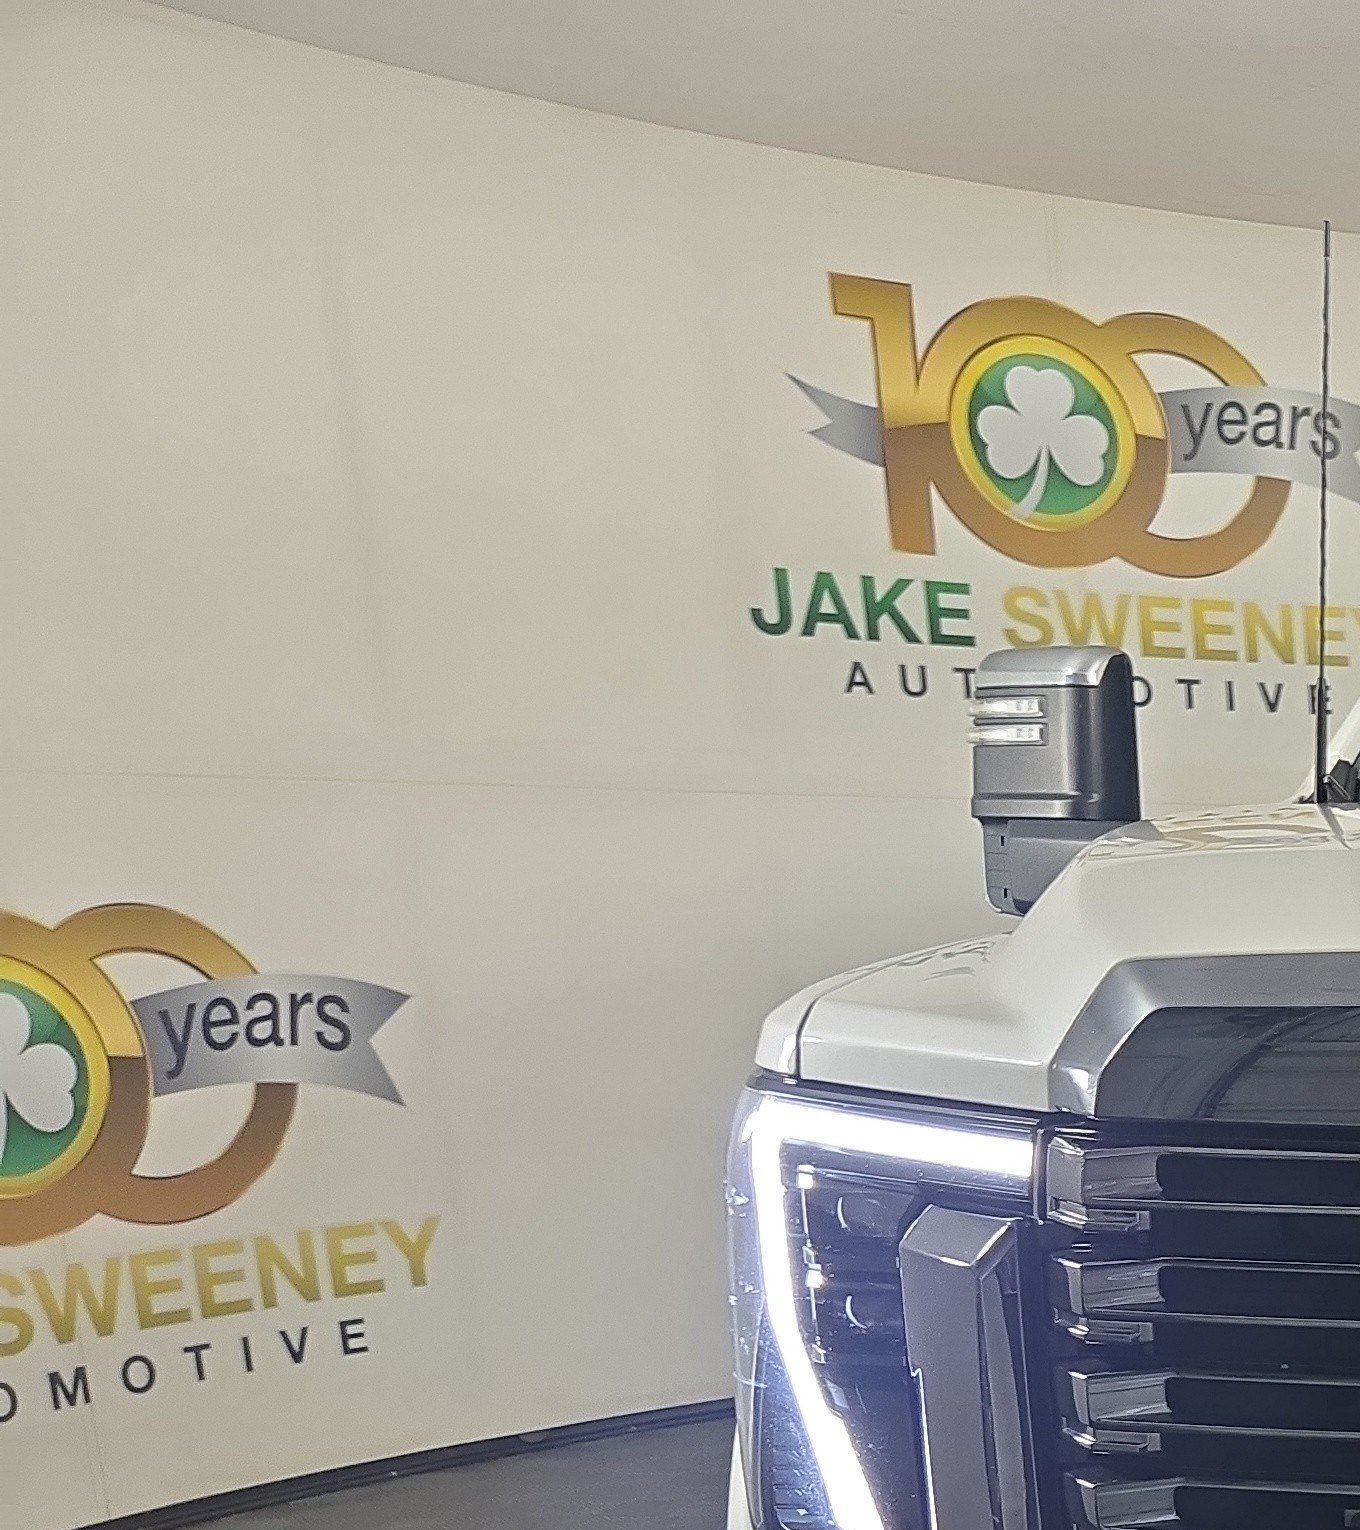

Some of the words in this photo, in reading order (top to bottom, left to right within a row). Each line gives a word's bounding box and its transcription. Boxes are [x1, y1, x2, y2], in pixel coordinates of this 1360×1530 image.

[1180, 394, 1343, 462] years
[750, 566, 976, 647] JAKE
[845, 661, 1335, 715] AUTOTIVE
[157, 991, 352, 1080] years
